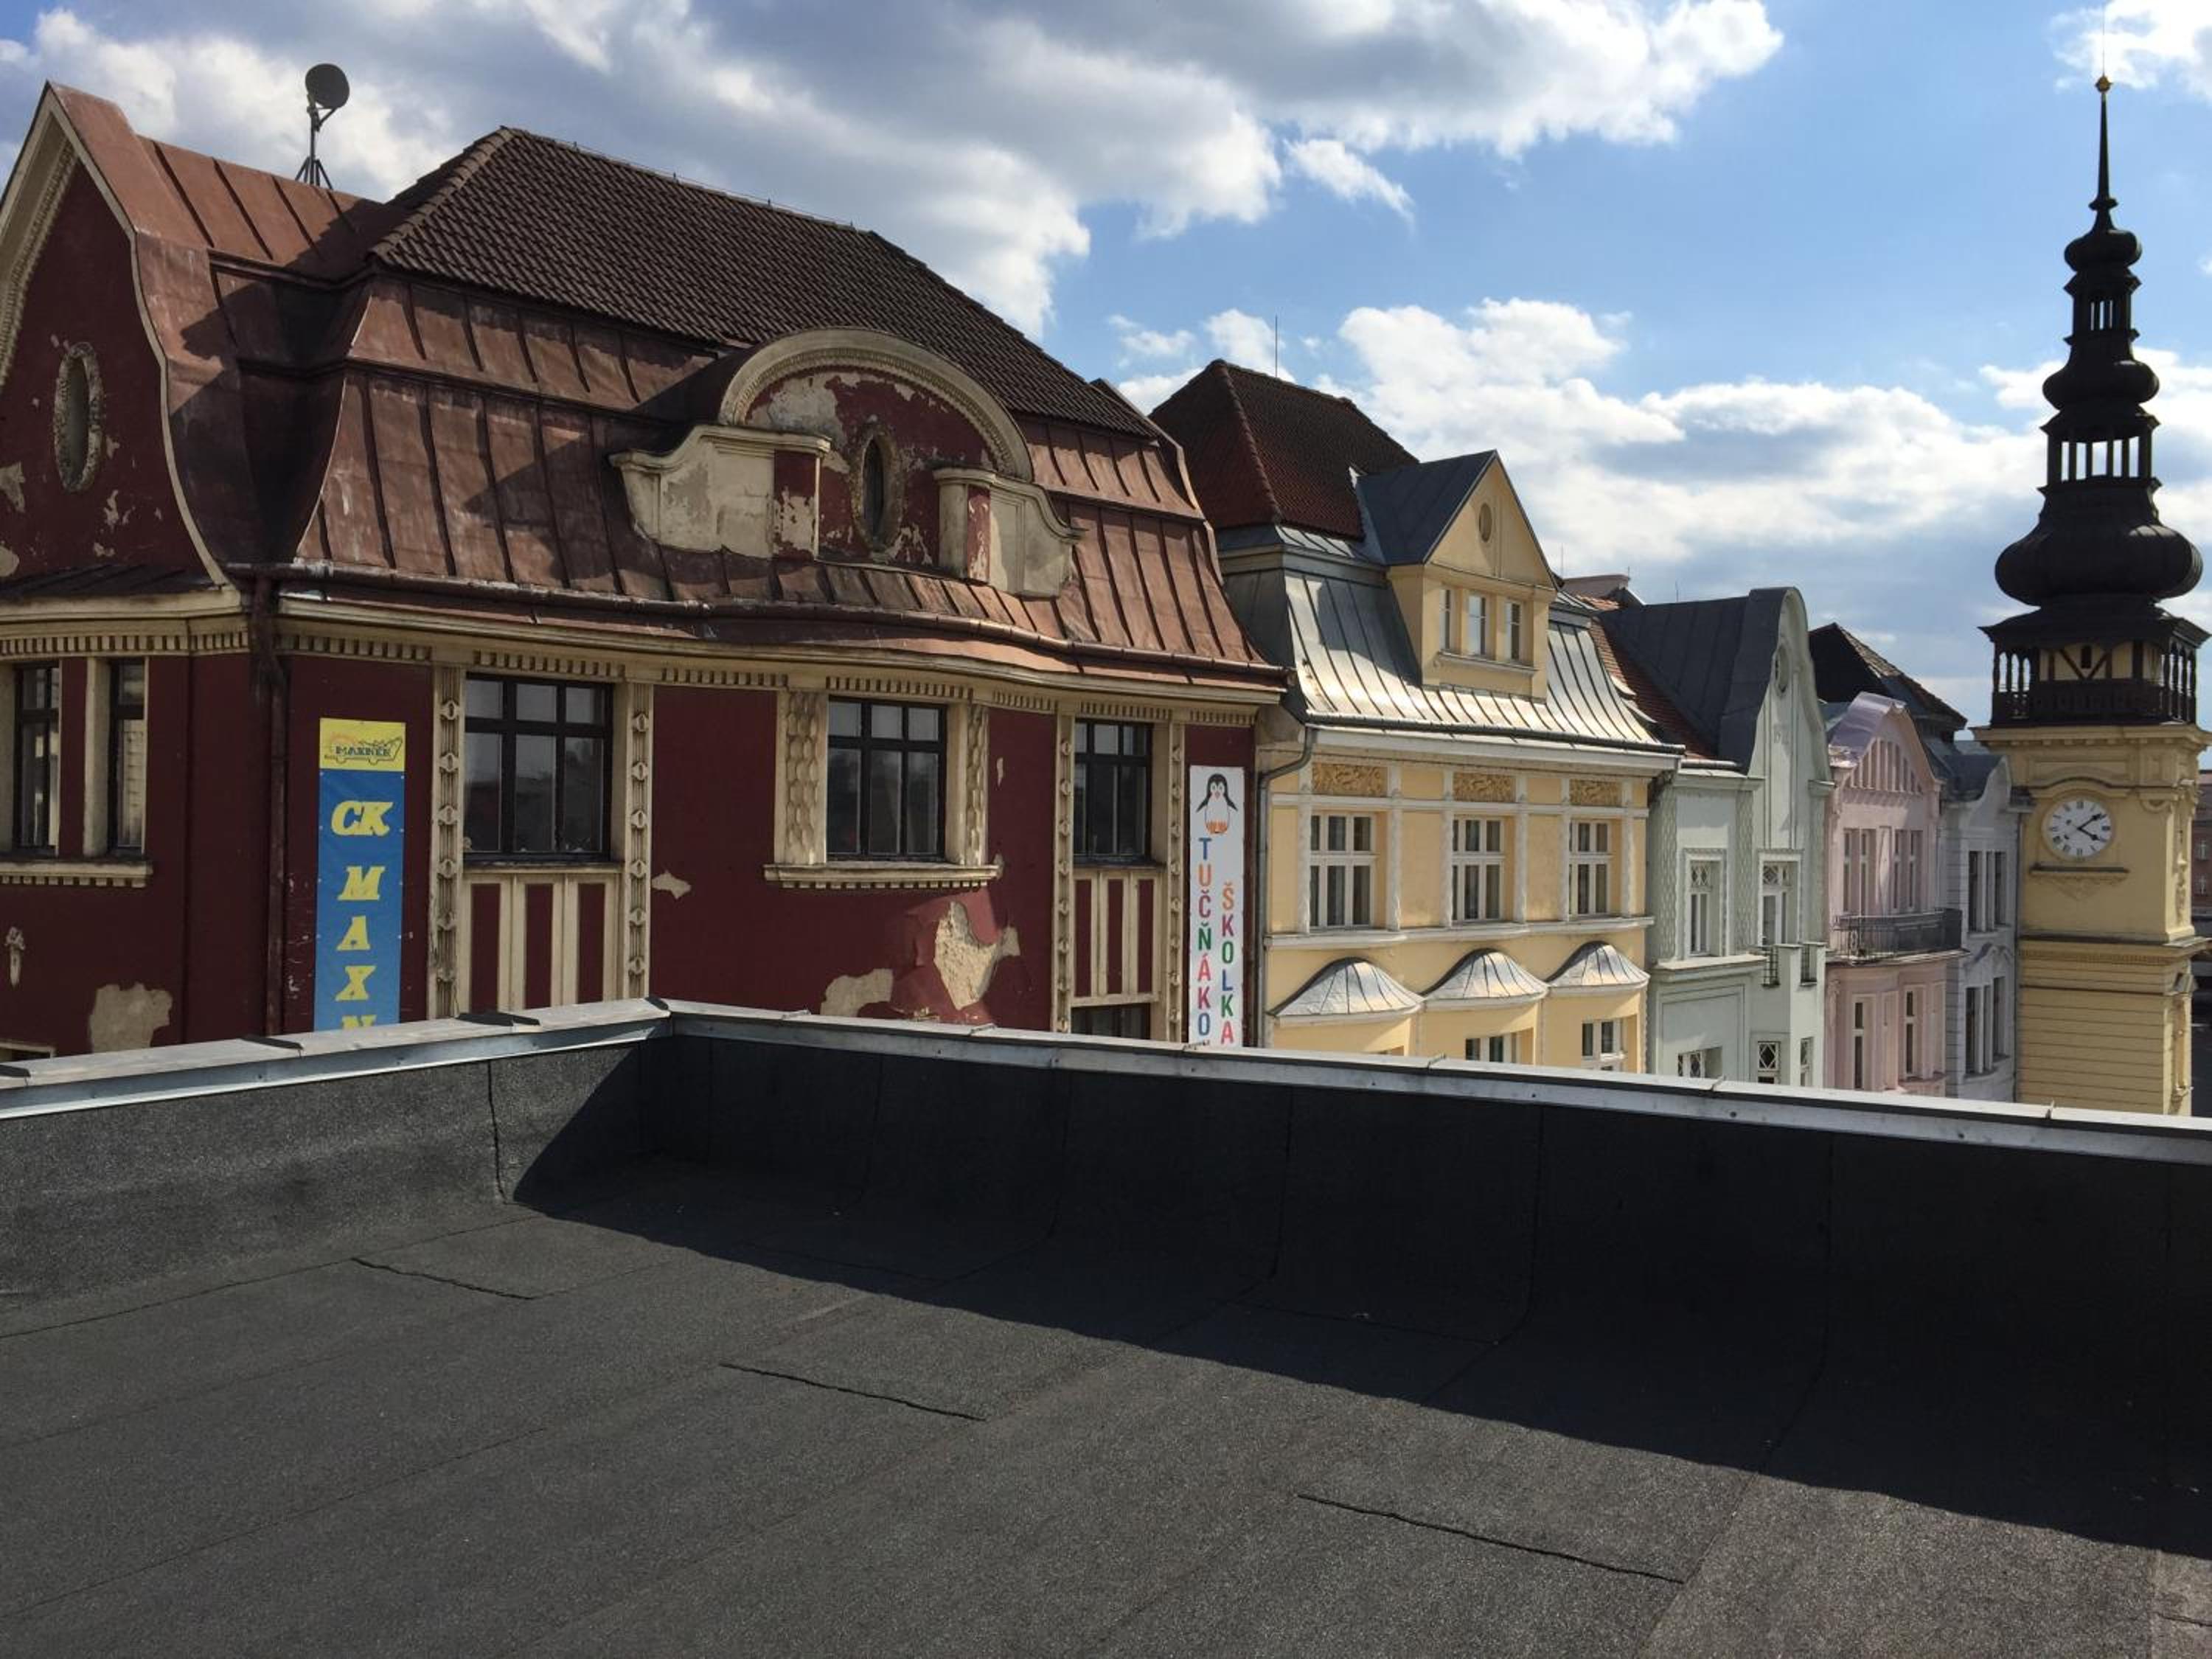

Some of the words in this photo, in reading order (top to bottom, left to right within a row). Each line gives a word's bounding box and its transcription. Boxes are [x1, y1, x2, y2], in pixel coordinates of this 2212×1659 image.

[331, 800, 394, 836] CK
[1197, 837, 1212, 1036] TUČŇÁKO
[1220, 881, 1235, 1045] ŠKOLKA
